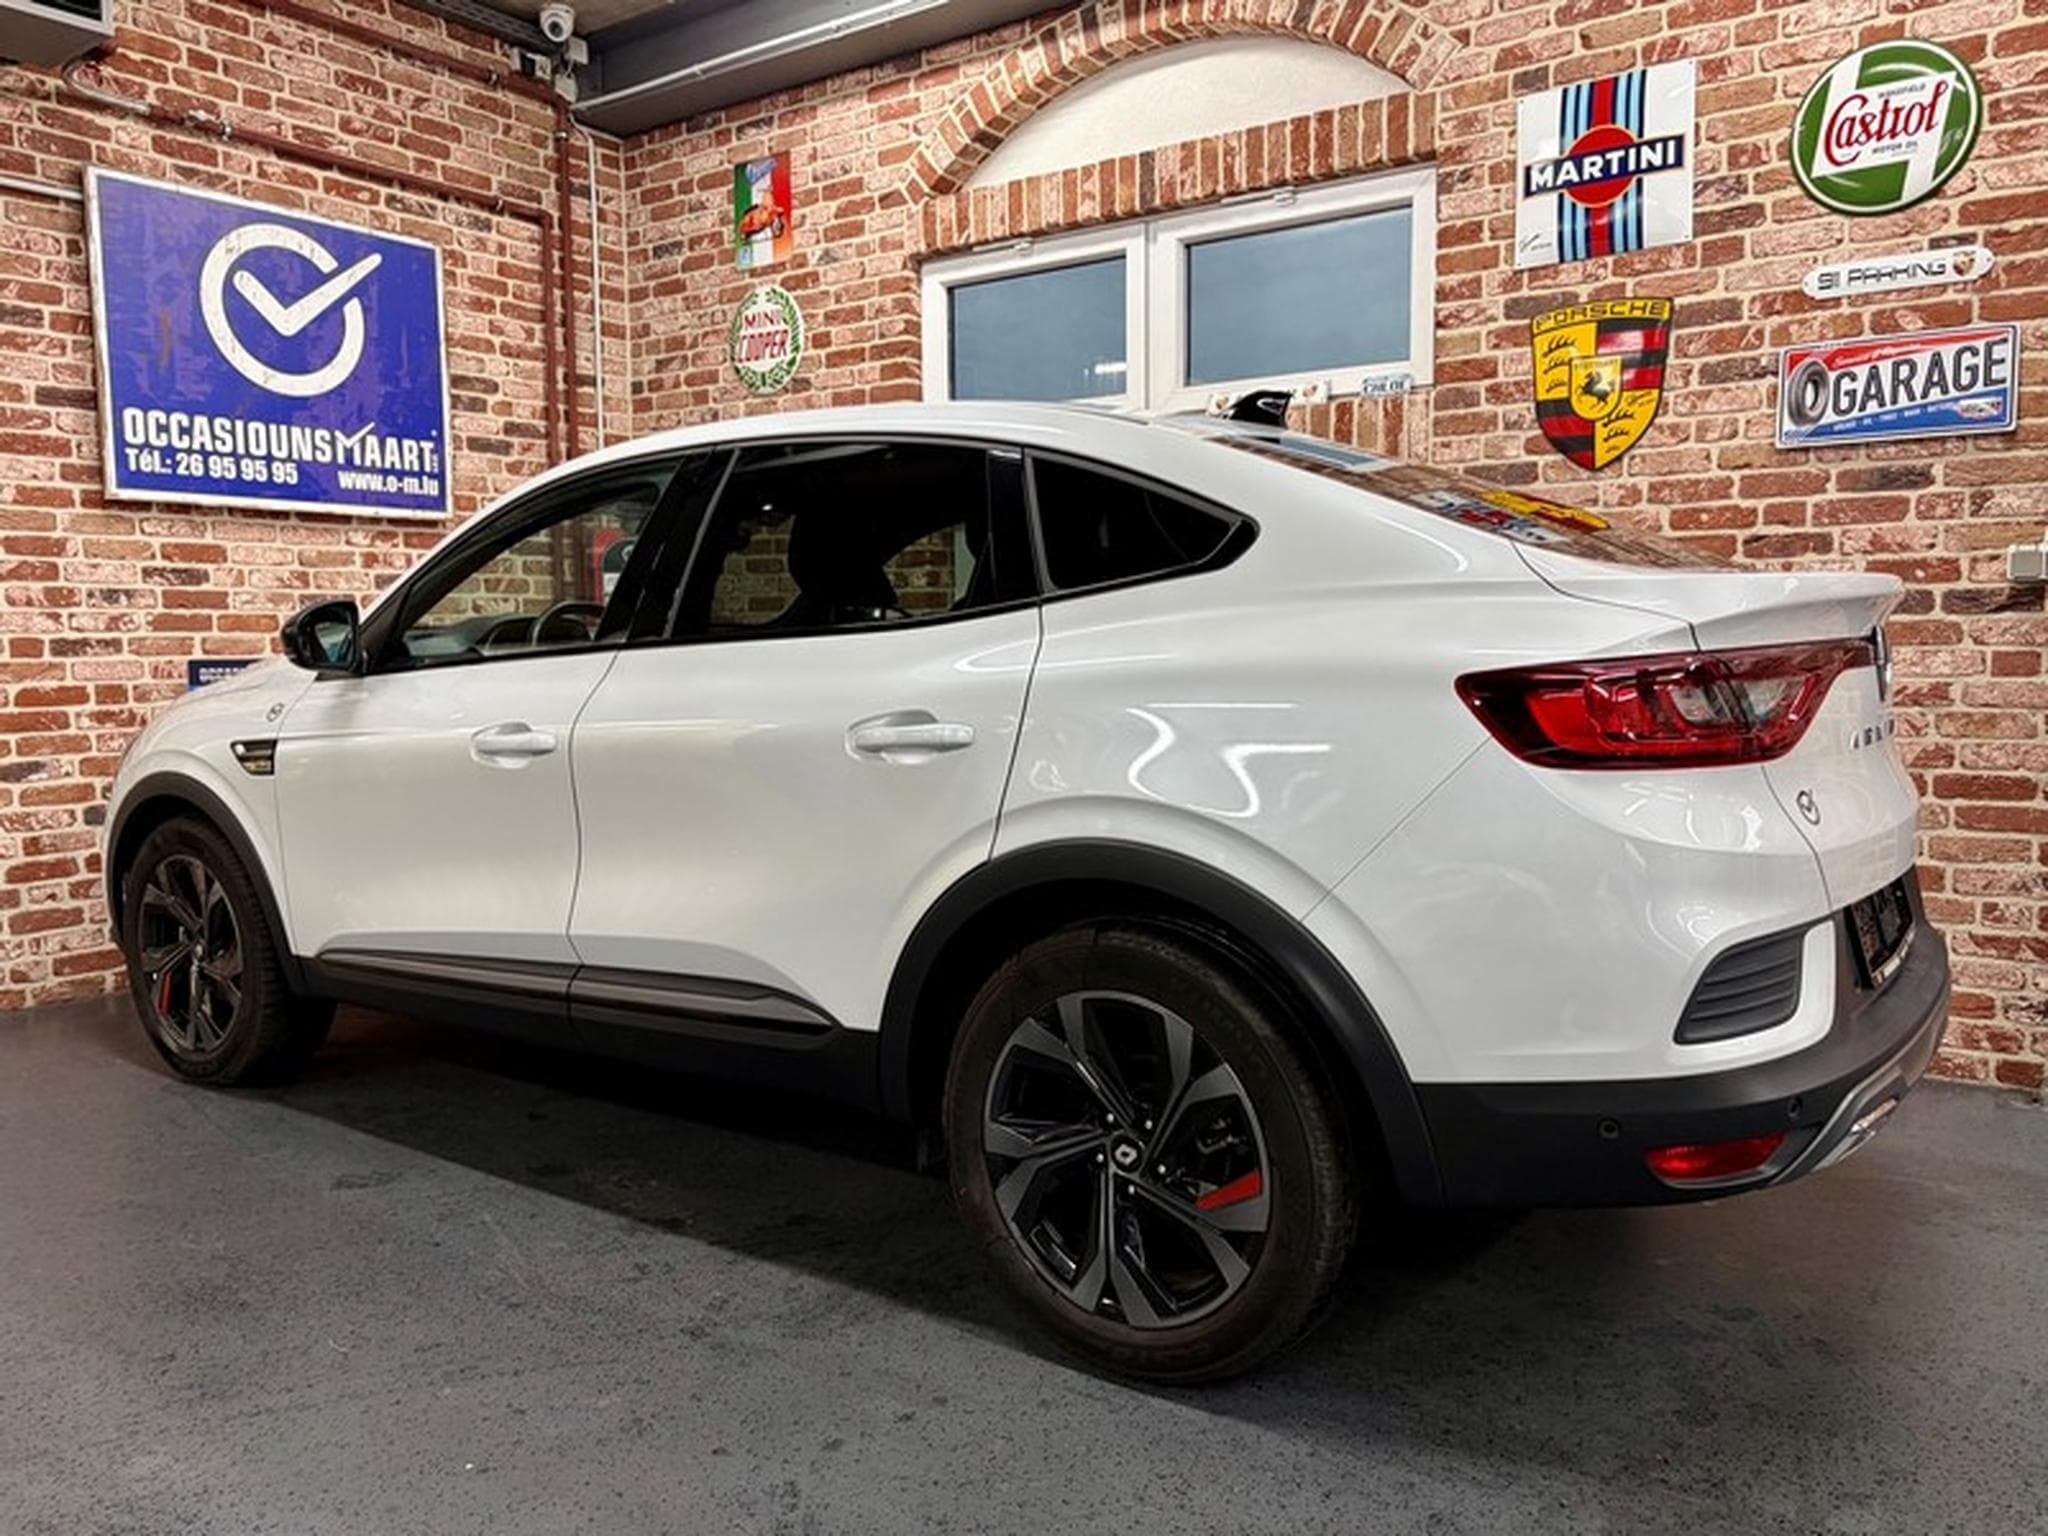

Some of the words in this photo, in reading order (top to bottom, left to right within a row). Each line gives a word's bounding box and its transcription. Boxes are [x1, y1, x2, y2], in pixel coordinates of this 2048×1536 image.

[1824, 80, 1949, 167] Castrol
[1529, 139, 1676, 193] MARTINI
[1847, 258, 1947, 287] PARKING
[744, 309, 783, 332] MINI
[1536, 302, 1666, 330] PORSCHE
[737, 329, 789, 363] COOPER
[1831, 337, 2009, 418] GARAGE
[125, 448, 173, 475] Tél.:
[175, 452, 205, 477] 26
[208, 455, 237, 480] 95
[240, 458, 269, 483] 95
[271, 460, 299, 485] 95
[337, 470, 440, 497] www.o-m.lu
